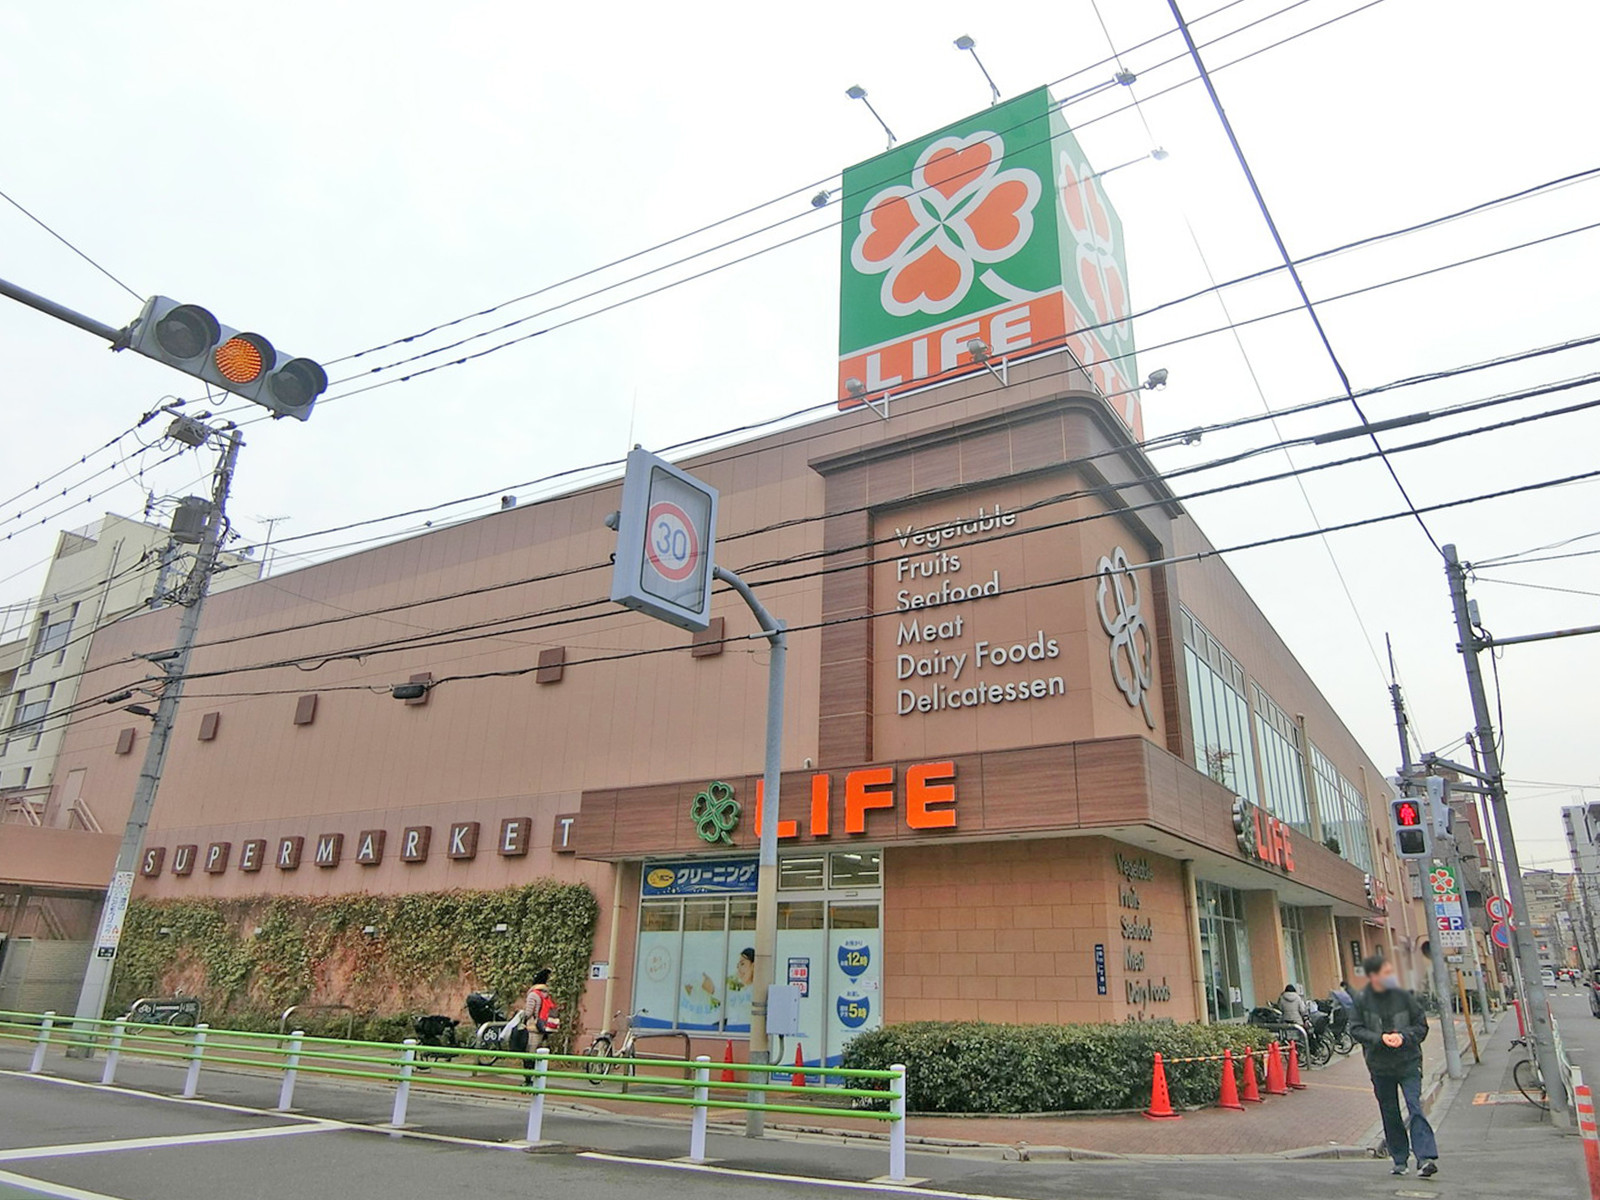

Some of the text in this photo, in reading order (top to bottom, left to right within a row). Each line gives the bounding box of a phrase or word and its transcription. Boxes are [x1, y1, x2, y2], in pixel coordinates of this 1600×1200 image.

[866, 305, 1032, 392] LIFE
[657, 522, 687, 561] 30
[895, 504, 1016, 548] Vegetable
[896, 552, 961, 582] Fruits
[896, 570, 1000, 612] Seafood
[897, 615, 964, 646] Meat
[897, 630, 1060, 680] Dairy Foods
[897, 676, 1065, 715] Delicatessen
[754, 761, 957, 838] LIFE
[144, 817, 575, 873] SUPERMARKET
[1253, 806, 1296, 872] LIFE
[677, 863, 756, 884] クリーニング
